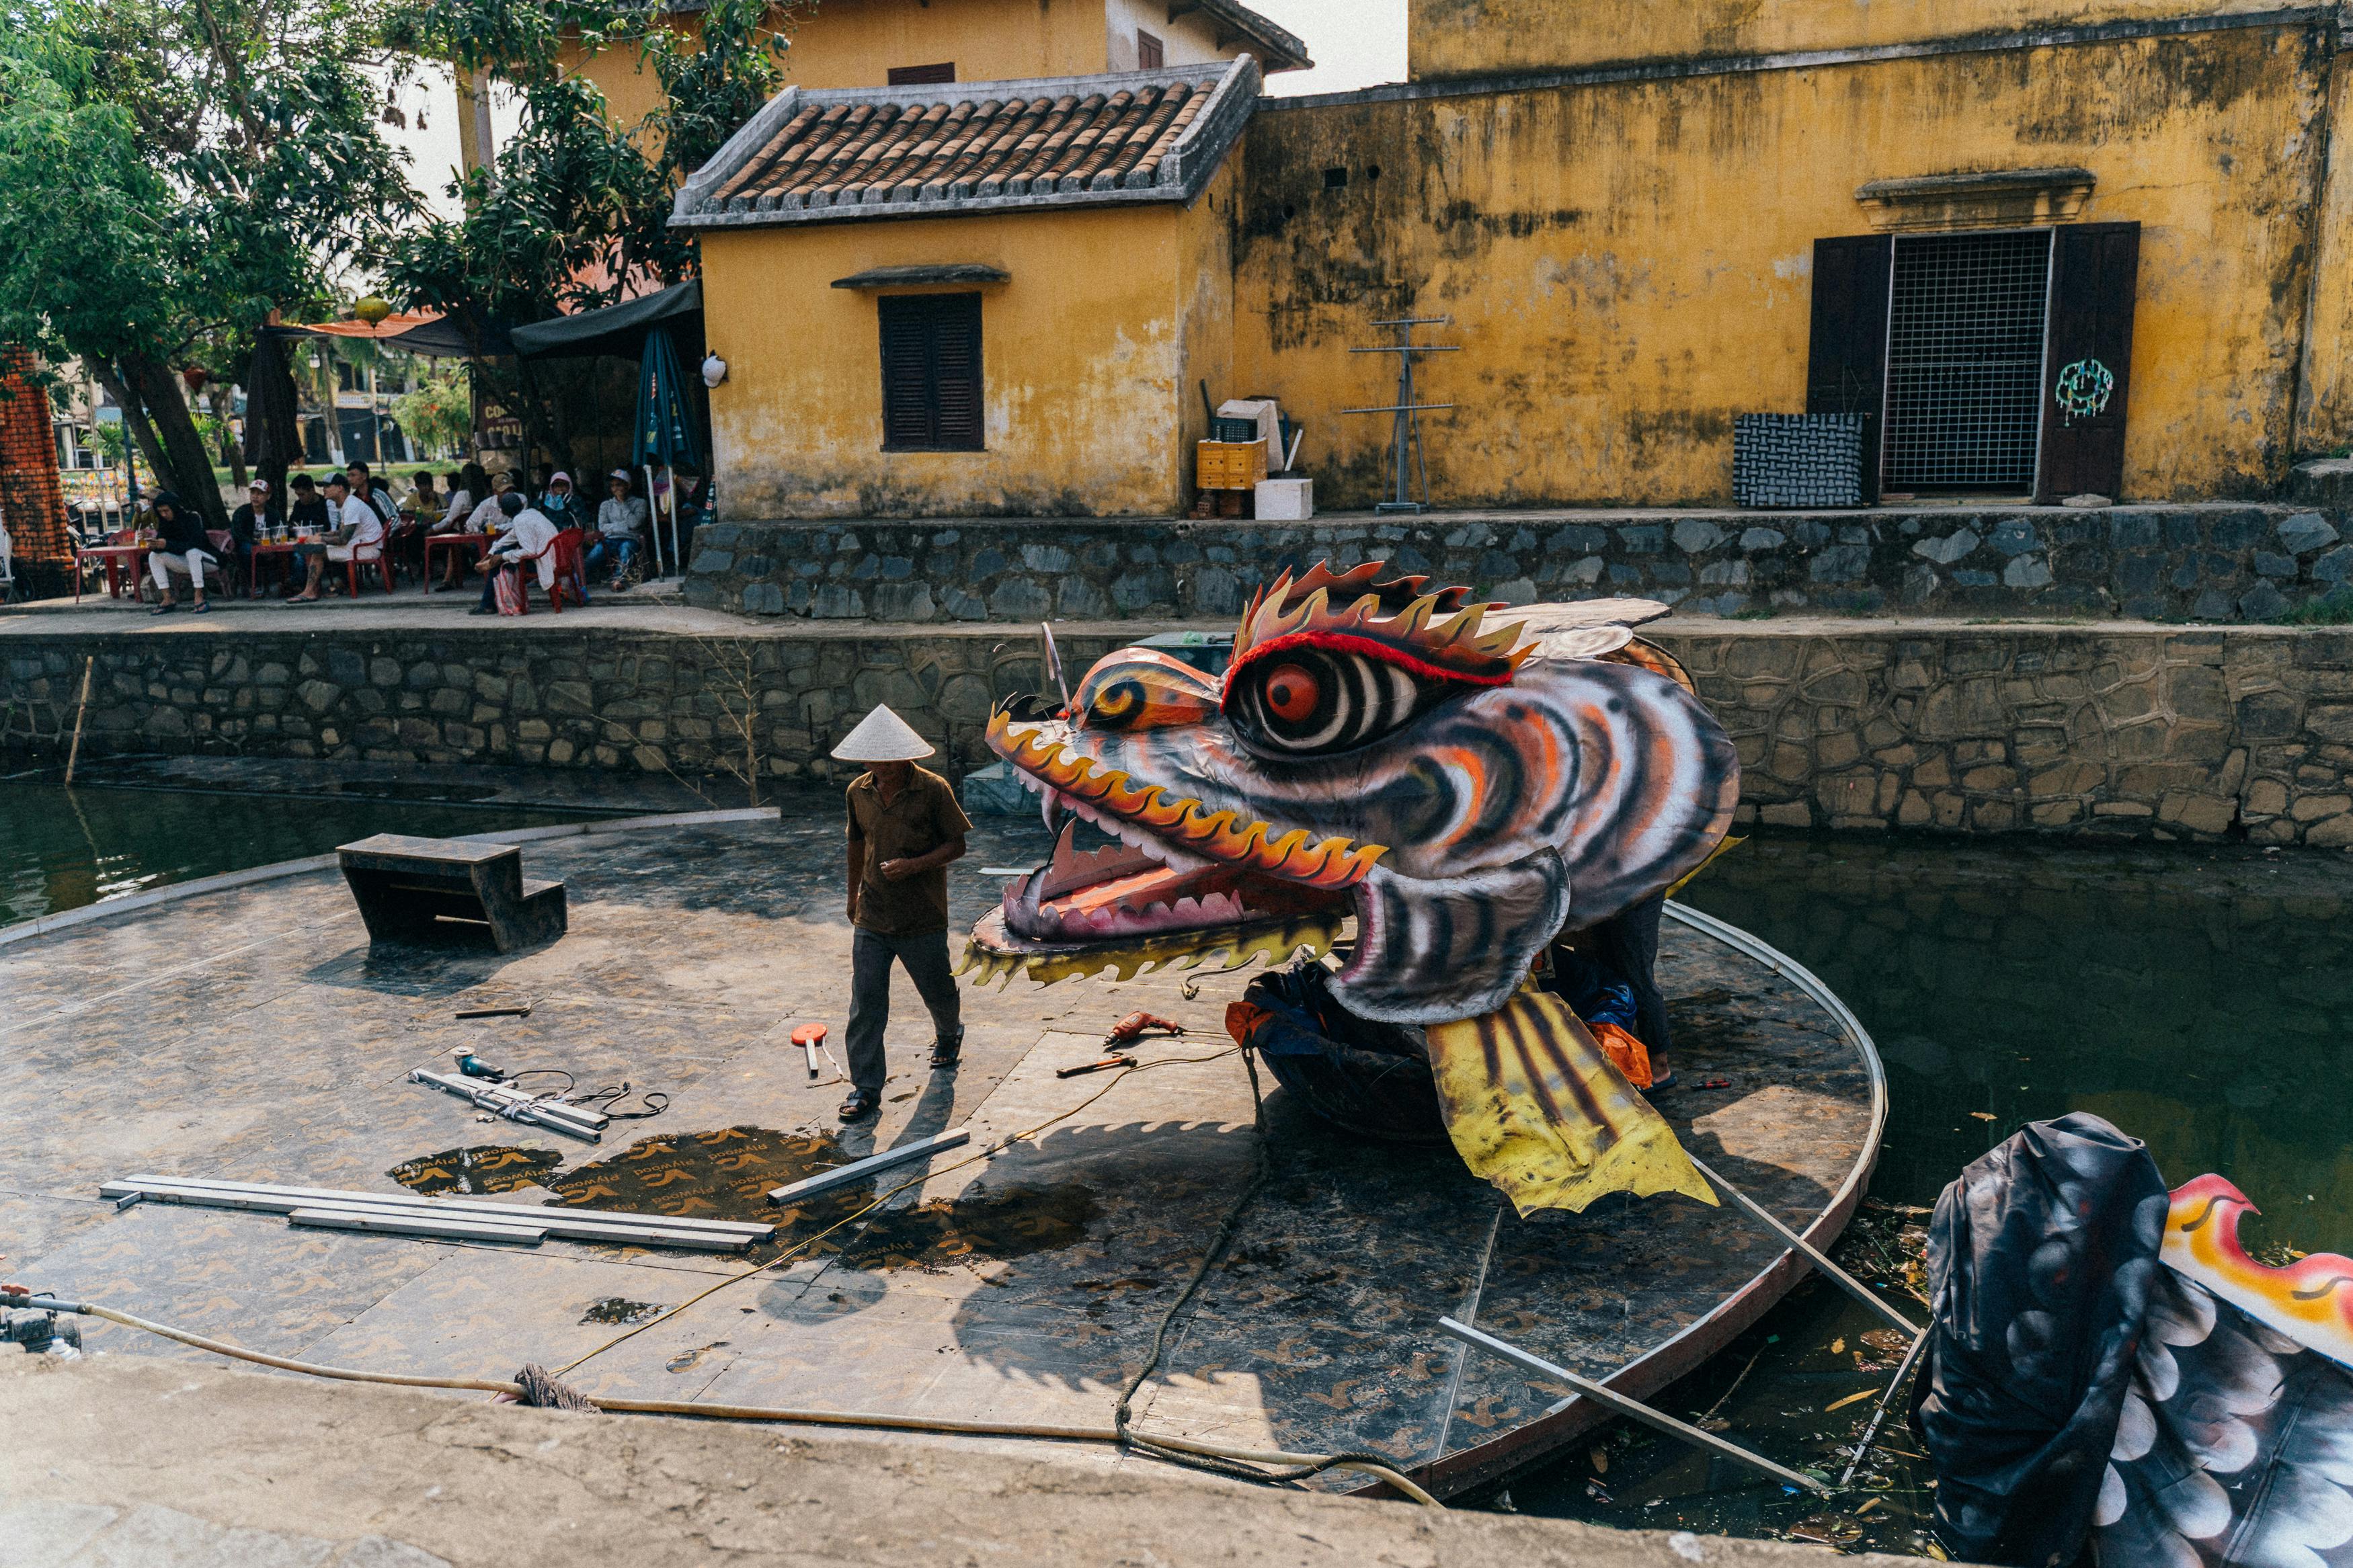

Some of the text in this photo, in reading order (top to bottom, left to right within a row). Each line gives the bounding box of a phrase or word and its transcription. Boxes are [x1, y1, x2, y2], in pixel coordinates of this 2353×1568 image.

[708, 1143, 768, 1160] Plywood
[634, 1158, 695, 1175] Plywood
[555, 1173, 620, 1192] Plywood
[651, 1186, 716, 1204] Plywood
